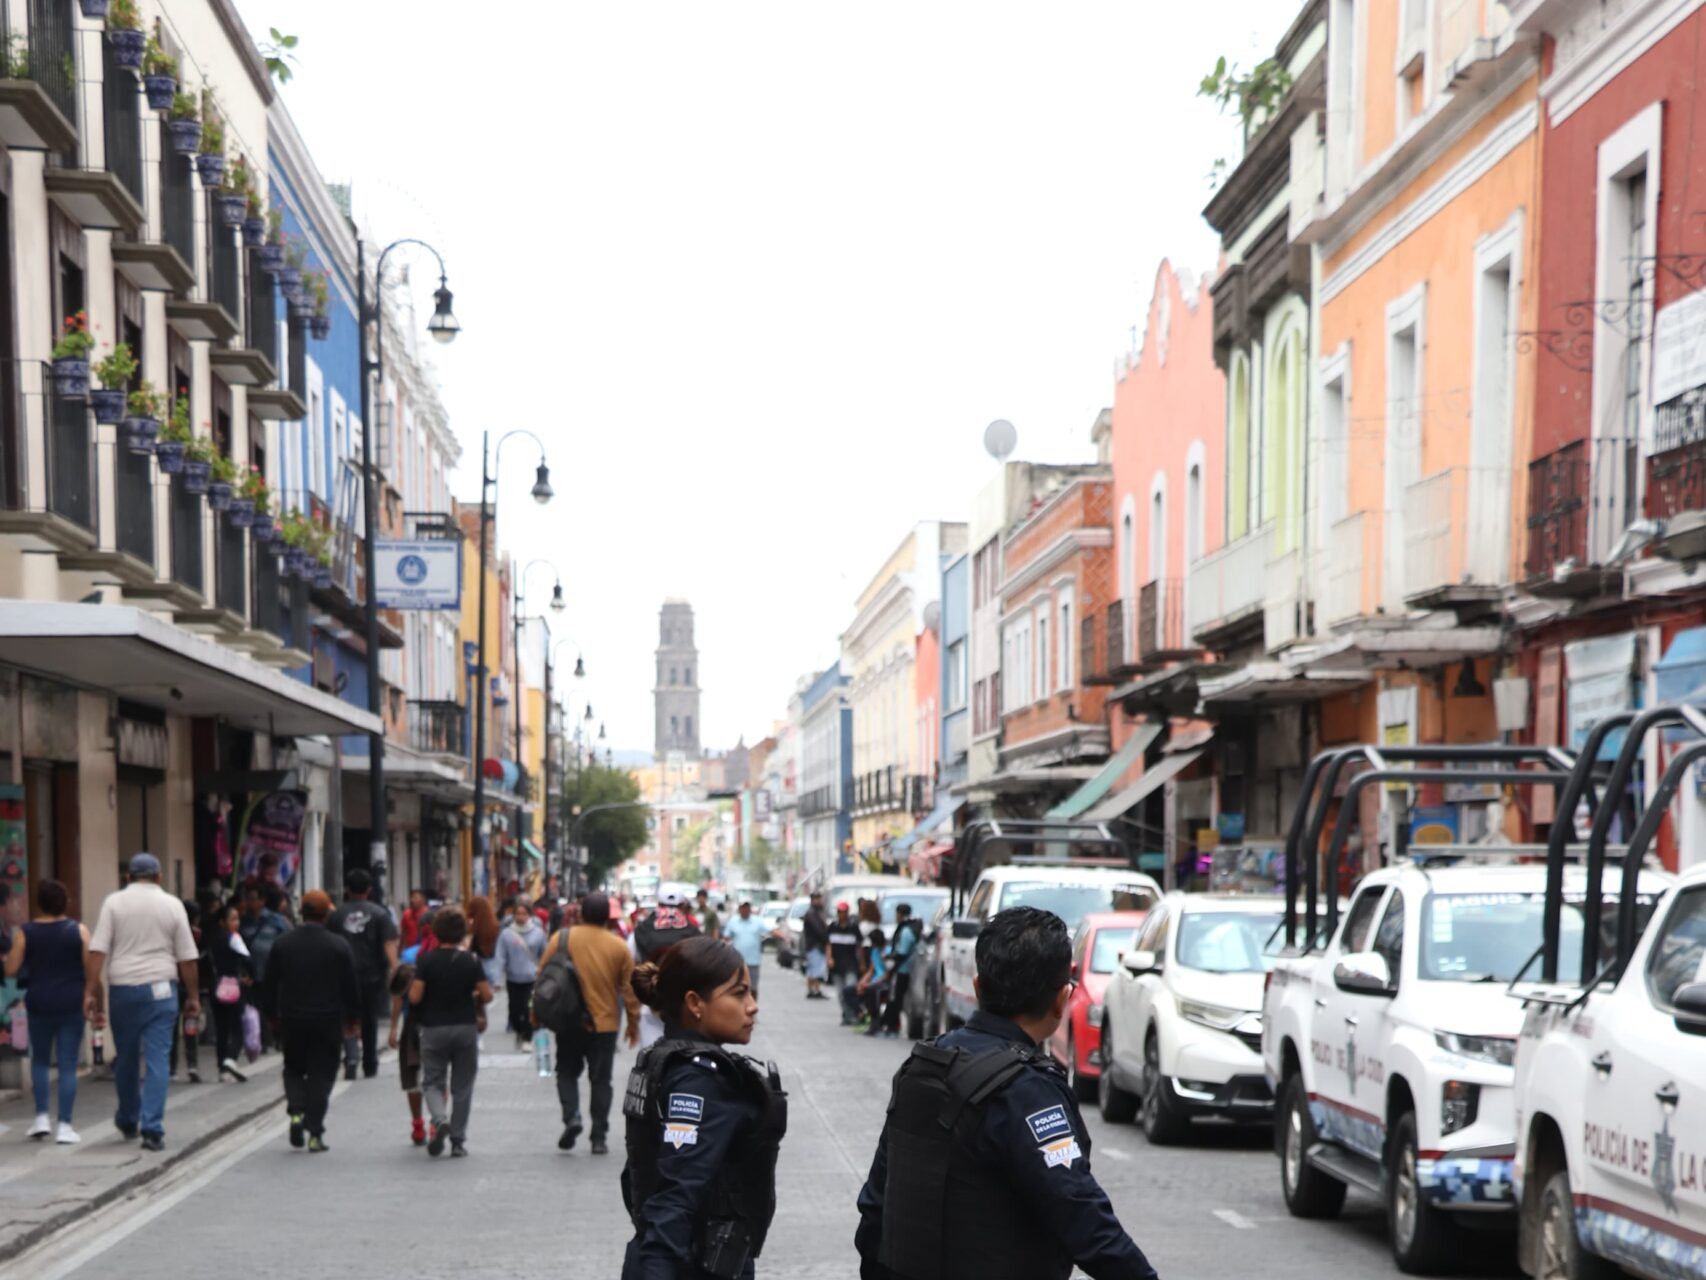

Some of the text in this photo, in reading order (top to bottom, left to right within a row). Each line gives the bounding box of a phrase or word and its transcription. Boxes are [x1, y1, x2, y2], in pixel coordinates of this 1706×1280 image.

[655, 907, 687, 930] 23
[1034, 1112, 1062, 1127] POLICÍA
[1583, 1121, 1629, 1170] POLICÍA
[1631, 1137, 1648, 1176] DE
[1679, 1151, 1698, 1191] LA
